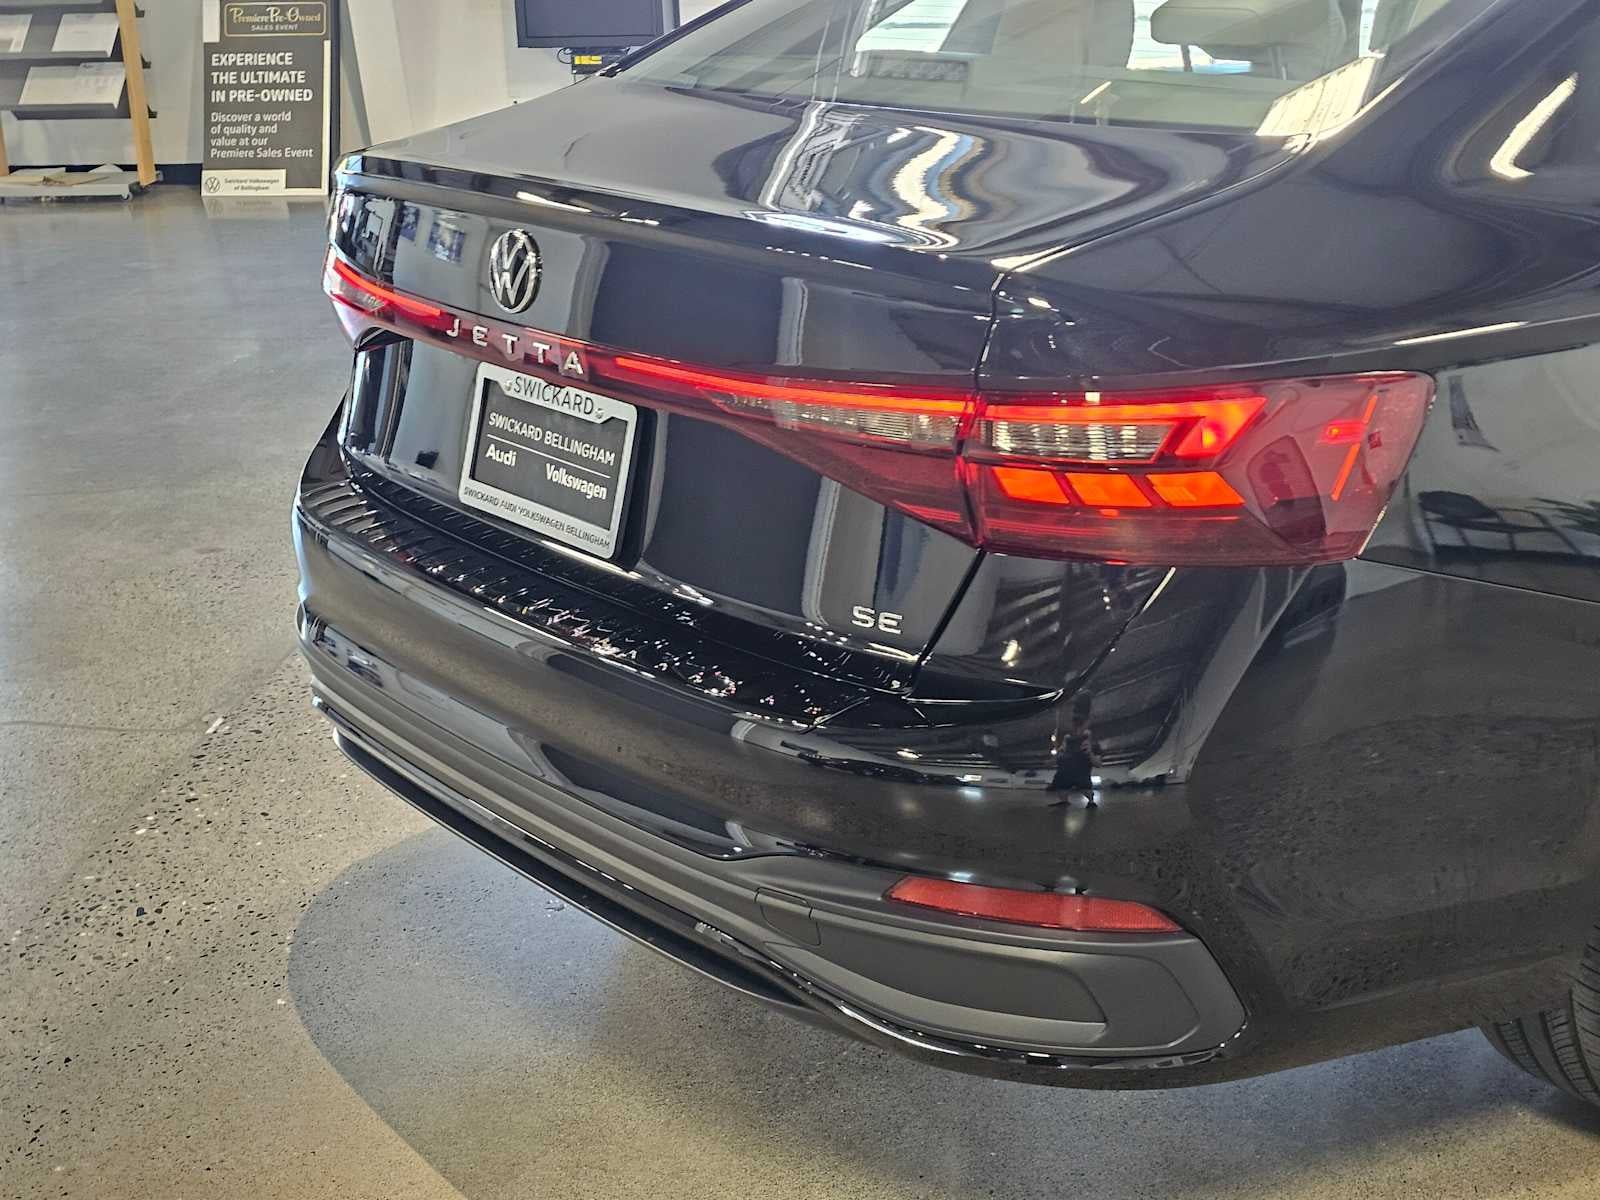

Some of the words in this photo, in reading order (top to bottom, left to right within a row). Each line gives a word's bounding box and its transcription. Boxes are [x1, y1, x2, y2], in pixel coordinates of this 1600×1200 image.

[211, 52, 294, 67] EXPERIENCE
[211, 71, 238, 85] THE
[240, 70, 306, 84] ULTIMATE
[211, 90, 226, 102] IN
[229, 89, 313, 102] PRE-OWNED
[211, 112, 253, 122] Discover
[254, 113, 261, 121] a
[262, 111, 292, 121] world
[210, 124, 221, 134] of
[223, 124, 257, 136] quality
[259, 123, 278, 133] and
[210, 137, 237, 146] value
[239, 137, 249, 146] at
[251, 138, 269, 146] our
[210, 148, 254, 158] Premiere
[256, 147, 282, 158] Sales
[284, 147, 313, 157] Event
[446, 318, 583, 375] JETTA
[513, 375, 594, 416] SWICKARD
[488, 412, 543, 442] SWICKARD
[544, 430, 616, 467] BELLINGHAM
[485, 443, 517, 467] Audi
[545, 463, 607, 500] Volkswagen
[464, 486, 499, 507] SWICKARD
[500, 500, 518, 513] AUDI
[565, 524, 610, 549] BELLINGHAM
[851, 605, 903, 635] SE
